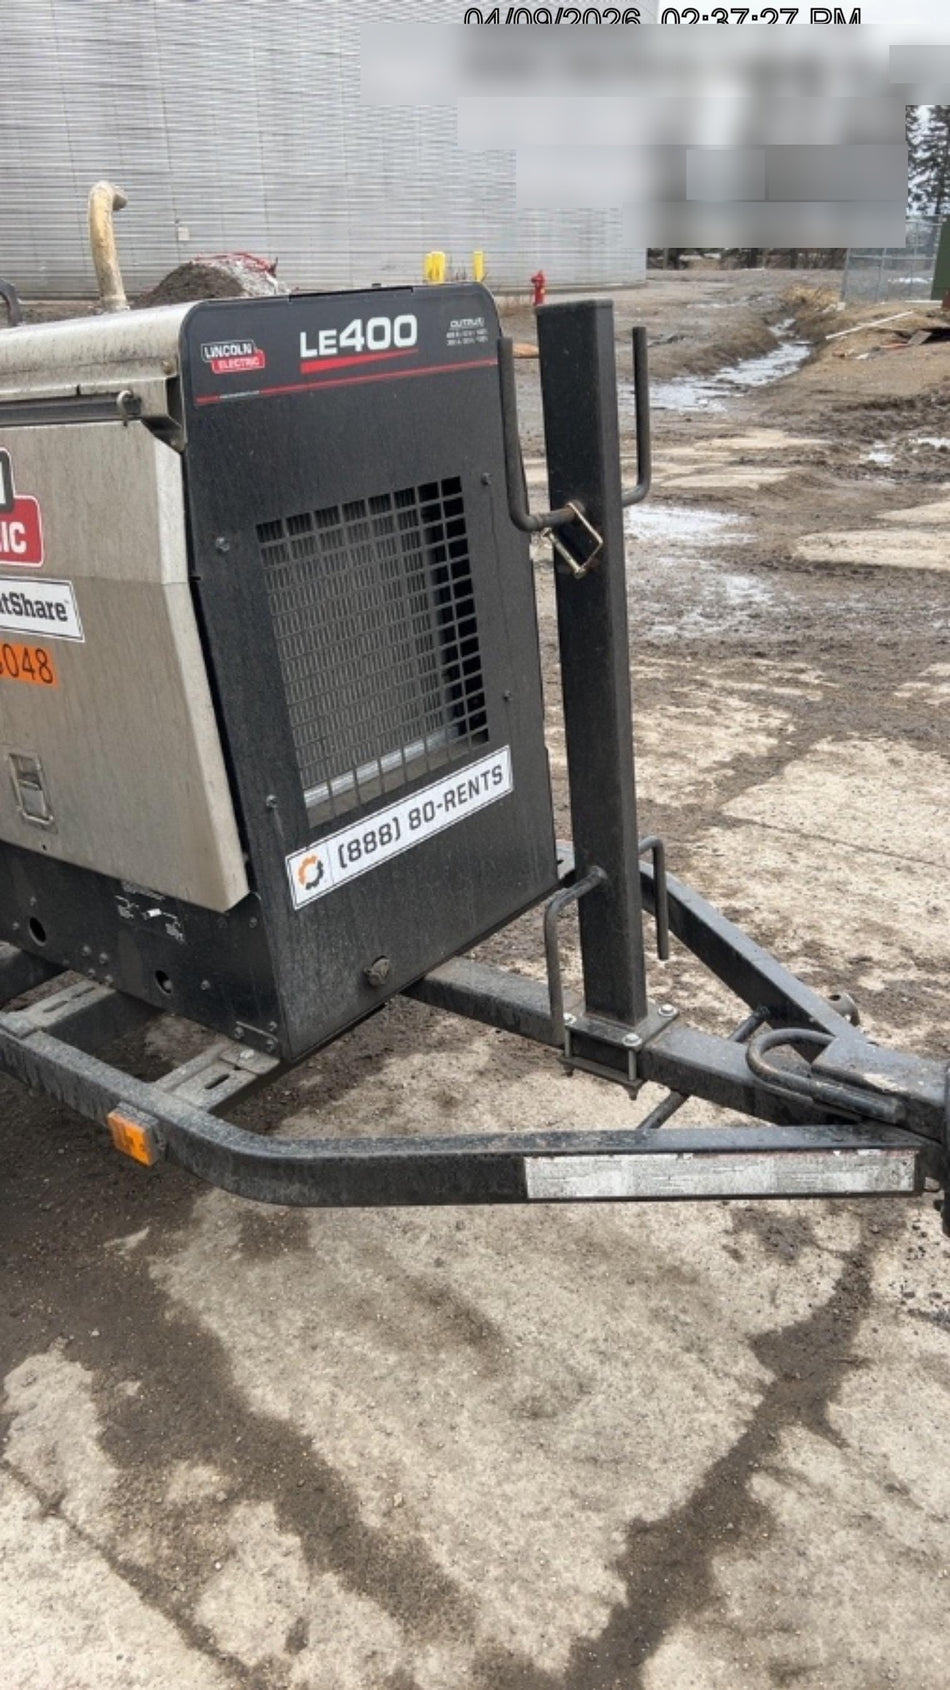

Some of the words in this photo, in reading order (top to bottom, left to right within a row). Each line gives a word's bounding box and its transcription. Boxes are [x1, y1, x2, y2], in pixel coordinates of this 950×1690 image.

[204, 343, 252, 358] LINCOLN
[300, 314, 417, 358] LE400
[218, 356, 260, 369] ELECTRIC
[0, 521, 27, 554] IC
[338, 817, 400, 868] (888)
[408, 765, 503, 831] 80-RENTS
